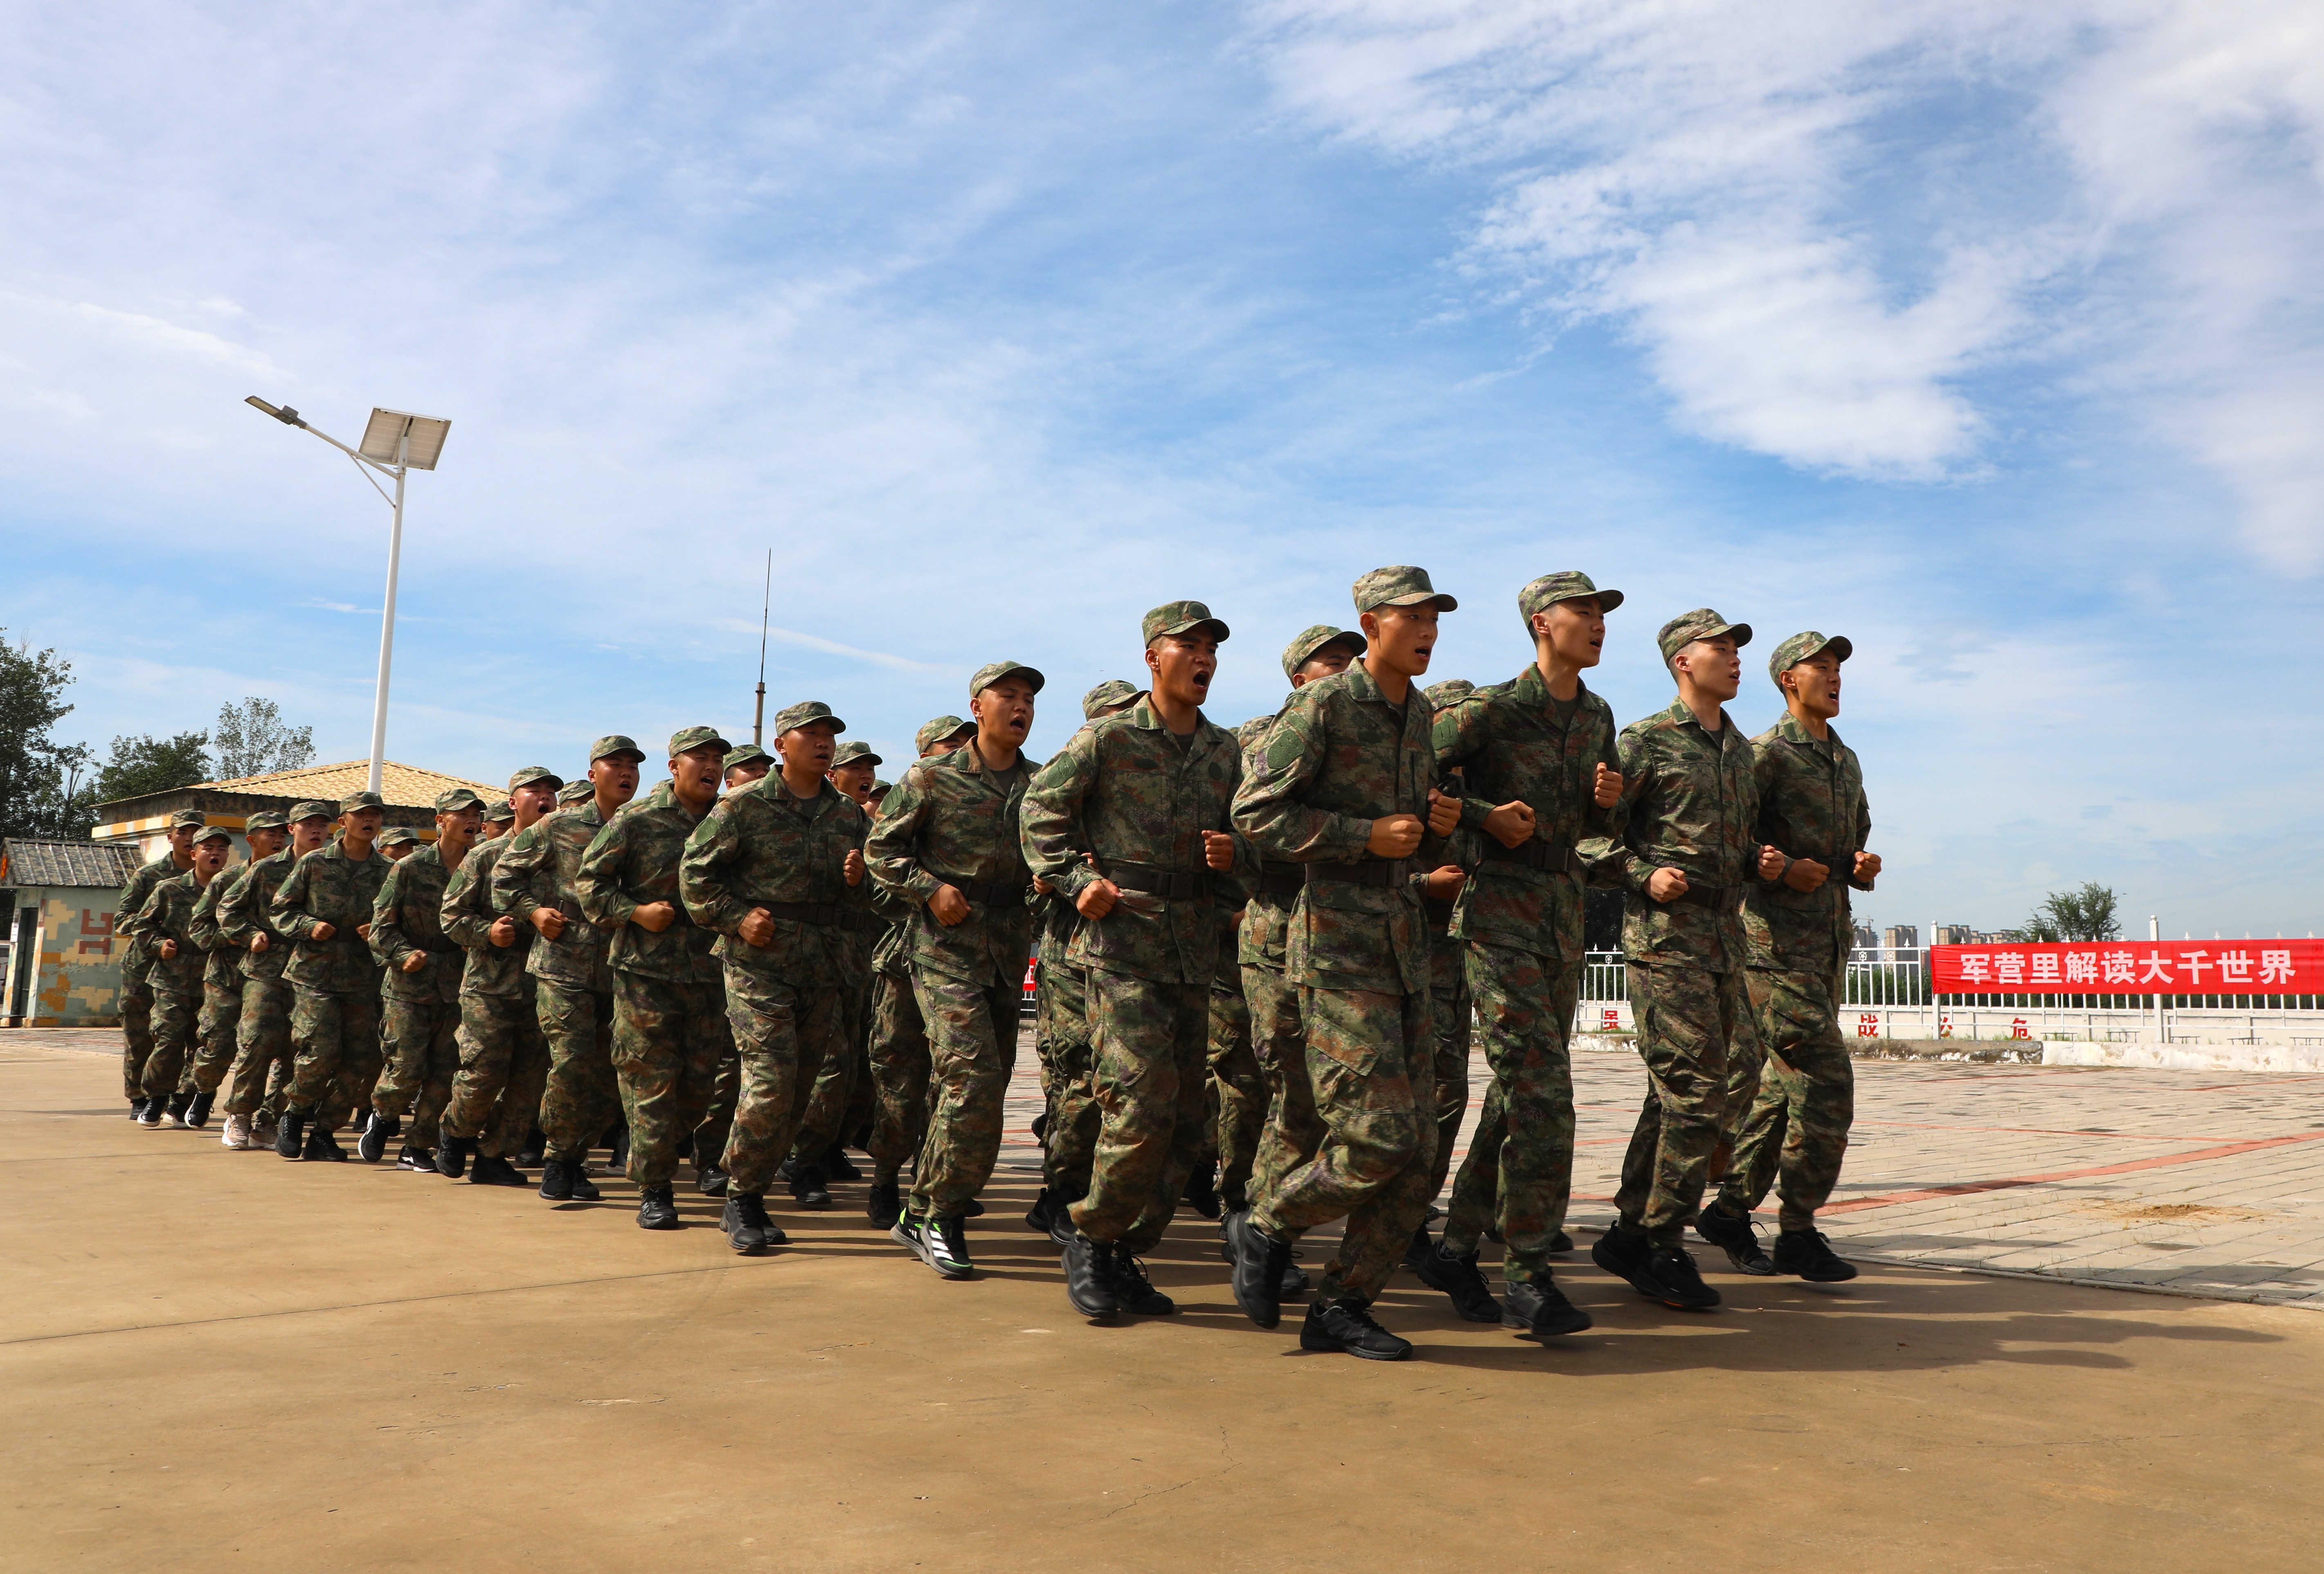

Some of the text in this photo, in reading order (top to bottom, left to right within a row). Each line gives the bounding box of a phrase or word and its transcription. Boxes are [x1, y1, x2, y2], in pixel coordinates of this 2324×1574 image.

[1960, 950, 2296, 985] 军营里解读大千世界
